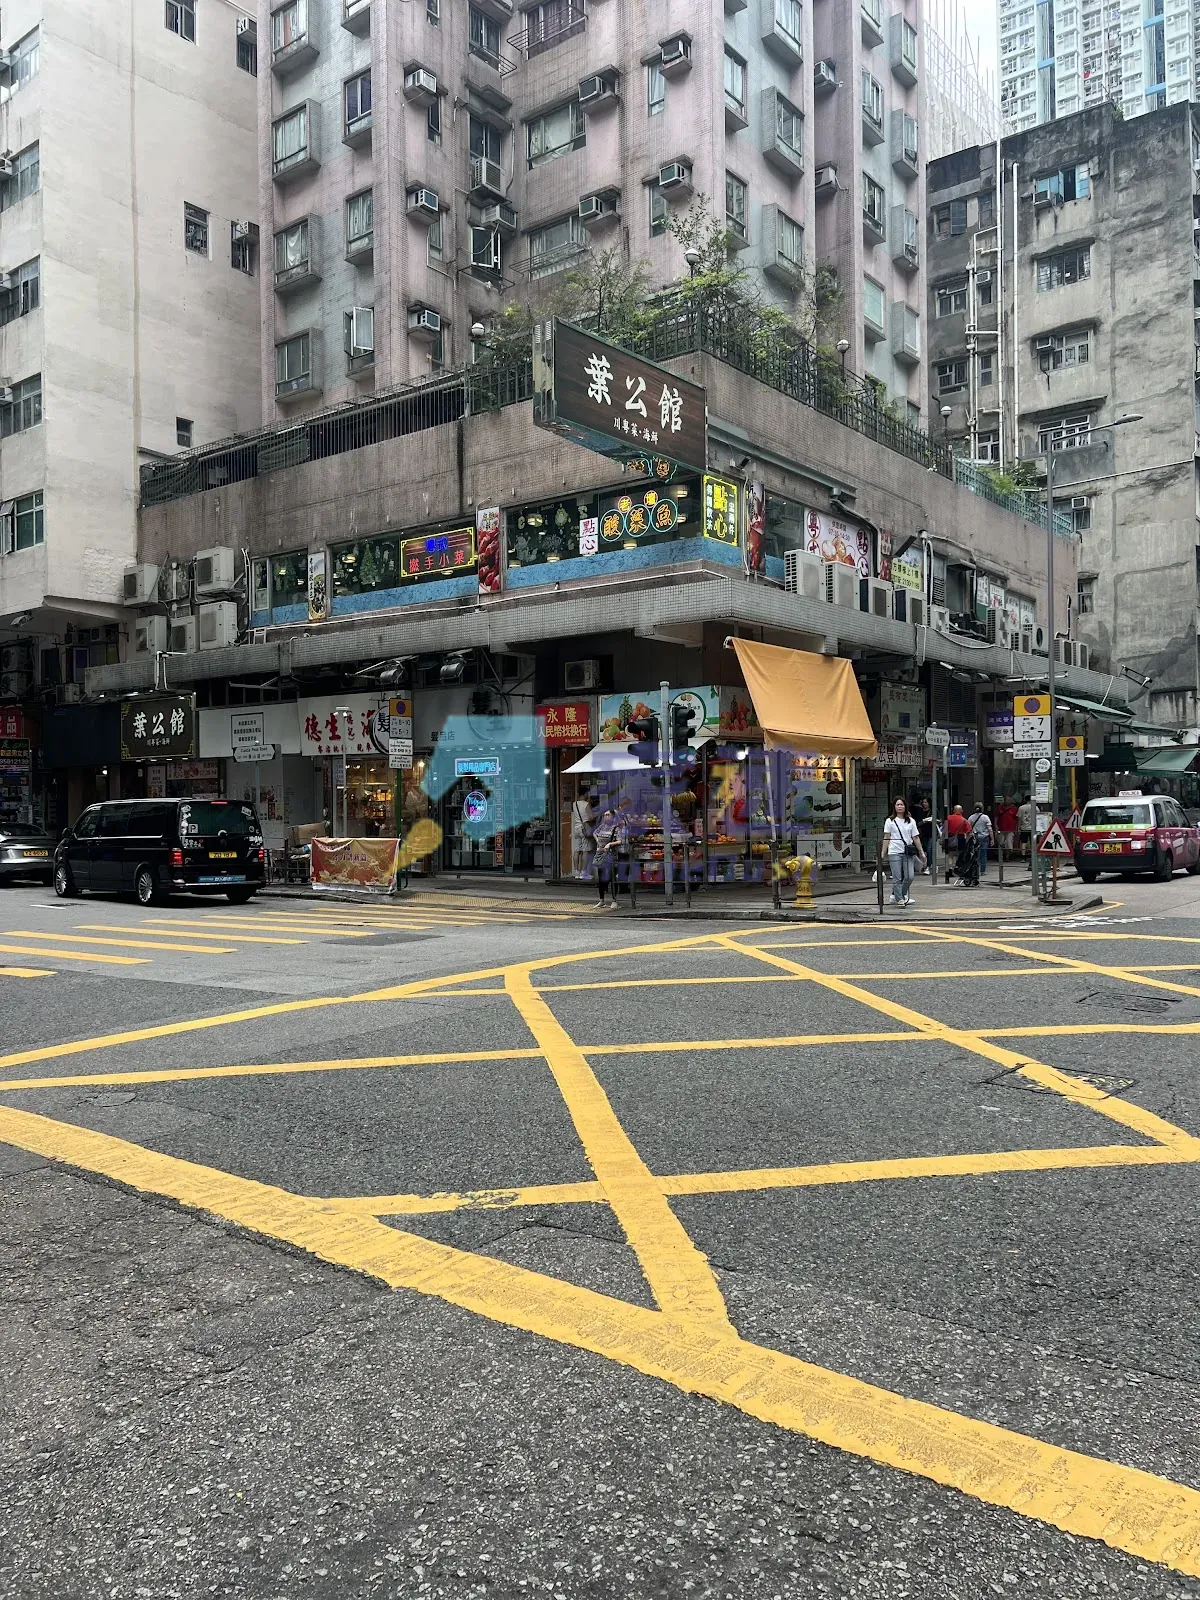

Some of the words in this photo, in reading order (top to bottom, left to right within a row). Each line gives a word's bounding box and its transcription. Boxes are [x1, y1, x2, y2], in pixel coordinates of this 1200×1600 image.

[583, 353, 684, 433] 葉公館
[582, 519, 596, 550] 點心
[132, 707, 185, 738] 葉公館
[547, 707, 577, 723] 永隆
[1038, 717, 1044, 726] 7
[1038, 730, 1044, 739] 7
